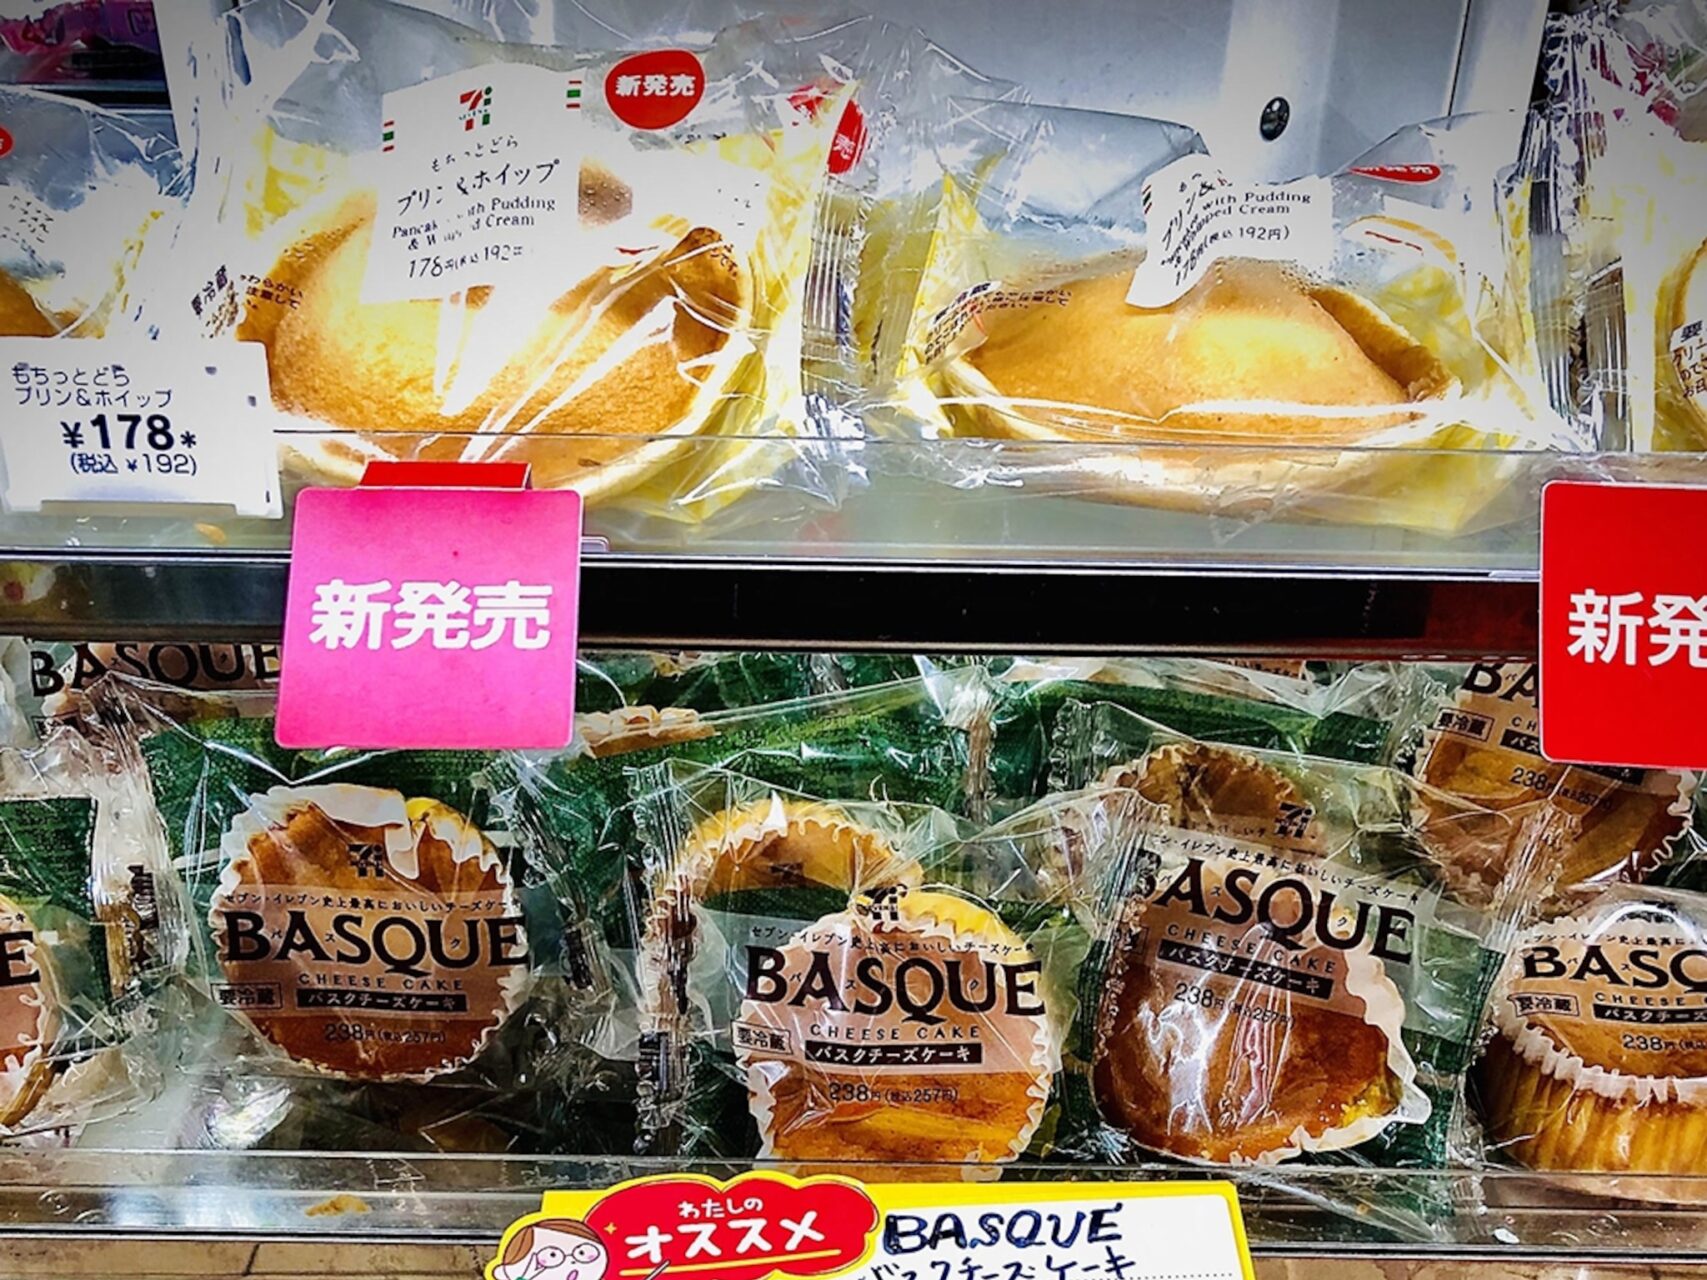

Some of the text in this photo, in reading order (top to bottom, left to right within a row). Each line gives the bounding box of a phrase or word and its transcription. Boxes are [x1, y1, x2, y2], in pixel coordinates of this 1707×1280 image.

[614, 74, 697, 97] 新発売
[491, 196, 556, 213] Pudding
[1244, 191, 1312, 204] Pudding
[485, 213, 535, 228] Cream
[1238, 204, 1291, 215] Cream
[12, 363, 130, 387] もちっとどら
[308, 579, 554, 650] 新発売
[222, 910, 530, 978] BASQUE
[1167, 924, 1255, 956] CHEESE
[1273, 949, 1337, 975] CAKE
[299, 974, 463, 992] CHEESE CAKE
[745, 944, 1046, 1026] BASQUE
[1594, 992, 1687, 1008] CHEESE
[810, 1023, 980, 1041] CHEESE CAKE
[814, 1045, 972, 1064] バスクチーズケーキ
[678, 1197, 764, 1219] わたしの
[624, 1210, 826, 1266] オススメ
[881, 1202, 1124, 1256] BASQUE
